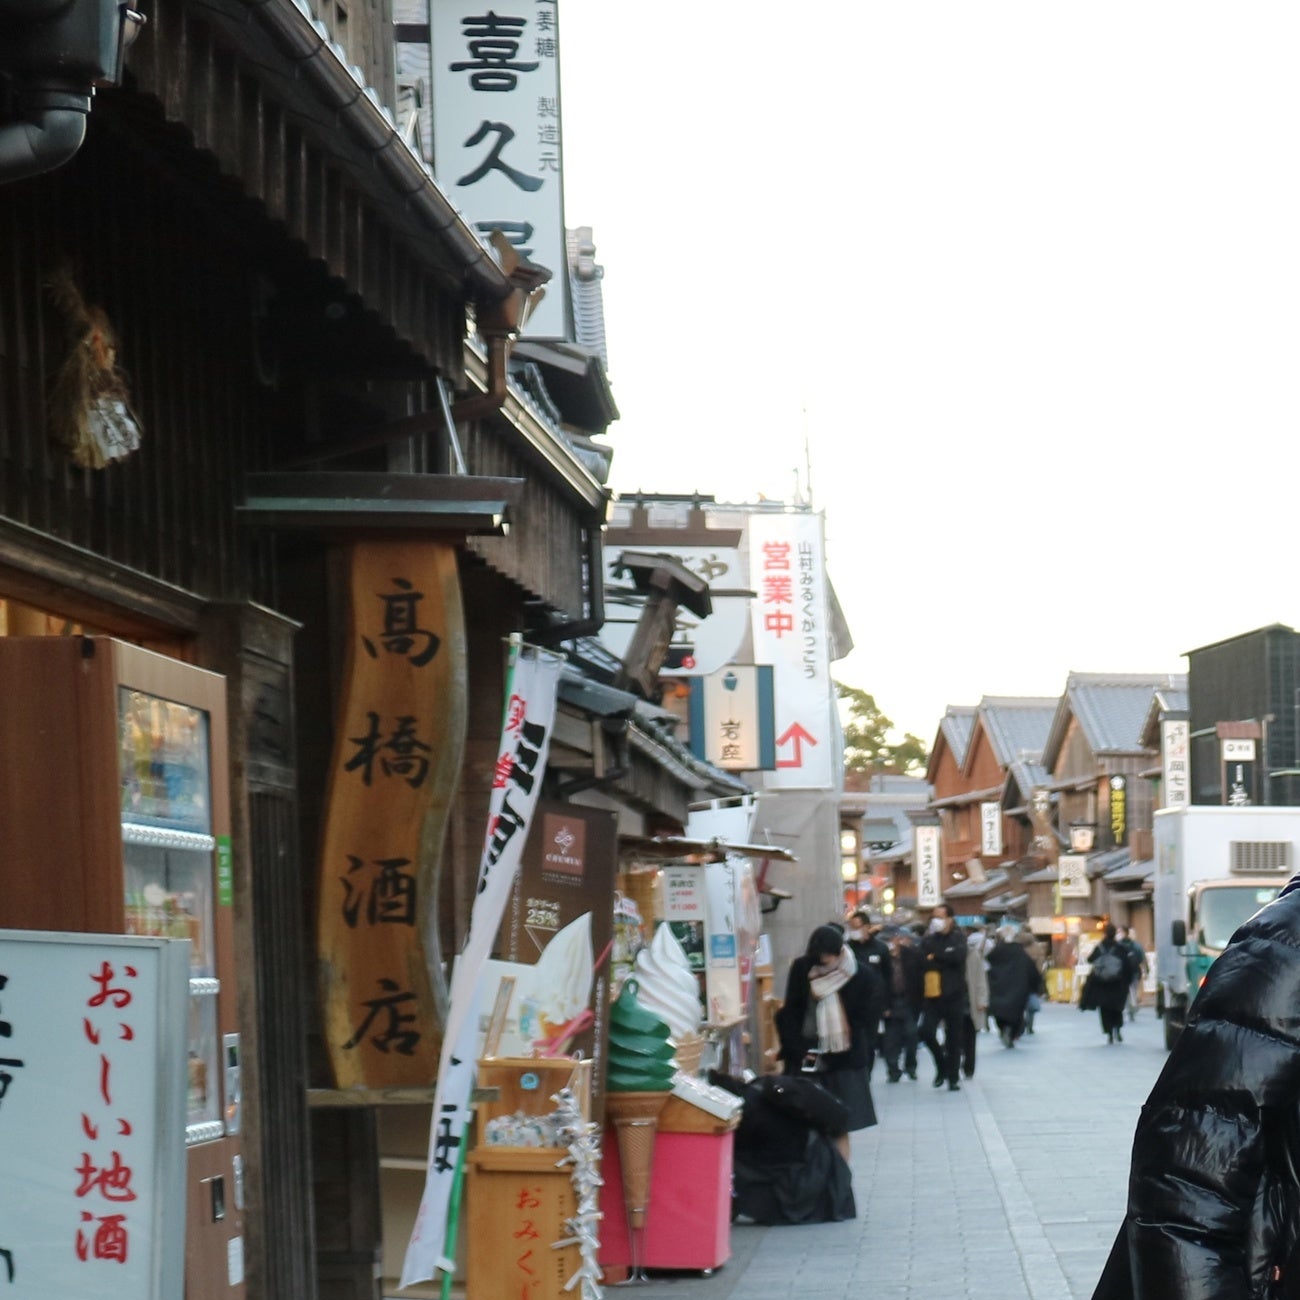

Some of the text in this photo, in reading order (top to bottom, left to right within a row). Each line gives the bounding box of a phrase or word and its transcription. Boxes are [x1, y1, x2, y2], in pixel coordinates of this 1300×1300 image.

[535, 0, 560, 173] 姜糖 製造元
[762, 540, 794, 639] 営業中
[798, 540, 817, 680] 山村みるくがっこう
[718, 718, 744, 761] 岩座
[526, 907, 559, 927] 25%
[74, 961, 138, 1264] おいしい地酒
